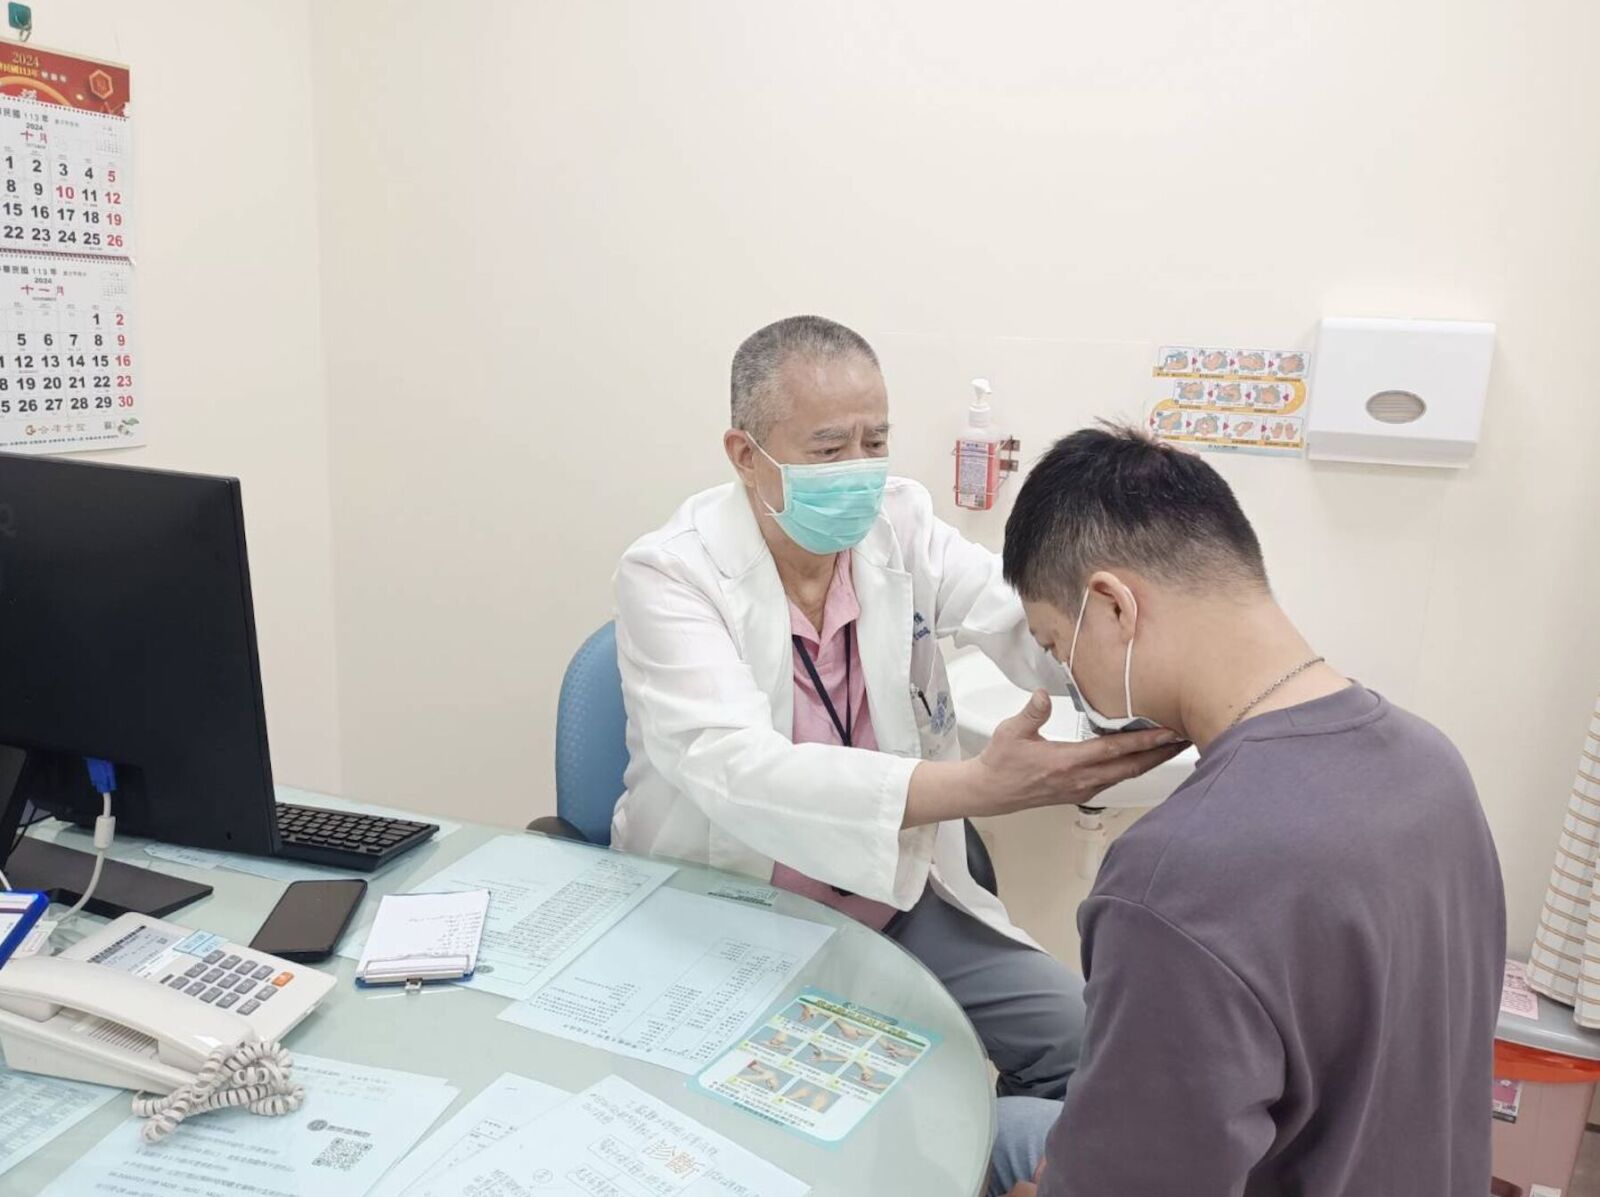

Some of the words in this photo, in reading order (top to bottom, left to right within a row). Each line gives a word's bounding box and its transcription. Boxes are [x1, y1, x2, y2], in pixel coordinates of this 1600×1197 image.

[25, 122, 43, 131] 2024
[5, 156, 14, 169] 1
[32, 160, 42, 172] 2
[59, 163, 68, 176] 3
[85, 168, 93, 179] 4
[108, 171, 115, 182] 5
[7, 180, 16, 193] 8
[34, 183, 43, 196] 9
[56, 186, 75, 199] 10
[82, 189, 97, 202] 11
[105, 192, 121, 204] 12
[3, 203, 23, 216] 15
[31, 206, 49, 219] 16
[58, 209, 75, 221] 17
[83, 211, 100, 224] 18
[106, 213, 122, 226] 19
[4, 226, 24, 239] 22
[32, 228, 51, 241] 23
[58, 231, 76, 243] 24
[83, 233, 101, 245] 25
[107, 235, 123, 247] 26
[93, 313, 100, 325] 1
[116, 314, 124, 326] 2
[18, 334, 26, 346] 5
[44, 334, 53, 346] 6
[70, 335, 78, 346] 7
[95, 335, 103, 346] 8
[117, 335, 125, 346] 9
[15, 357, 33, 368] 12
[42, 356, 59, 367] 13
[68, 356, 85, 367] 14
[92, 356, 108, 367] 15
[115, 356, 131, 367] 16
[17, 378, 35, 390] 19
[43, 377, 61, 390] 20
[69, 377, 85, 389] 21
[93, 376, 110, 388] 22
[117, 376, 132, 387] 23
[19, 400, 38, 412] 26
[45, 399, 62, 411] 27
[71, 398, 88, 410] 28
[95, 397, 112, 408] 29
[119, 396, 133, 407] 30
